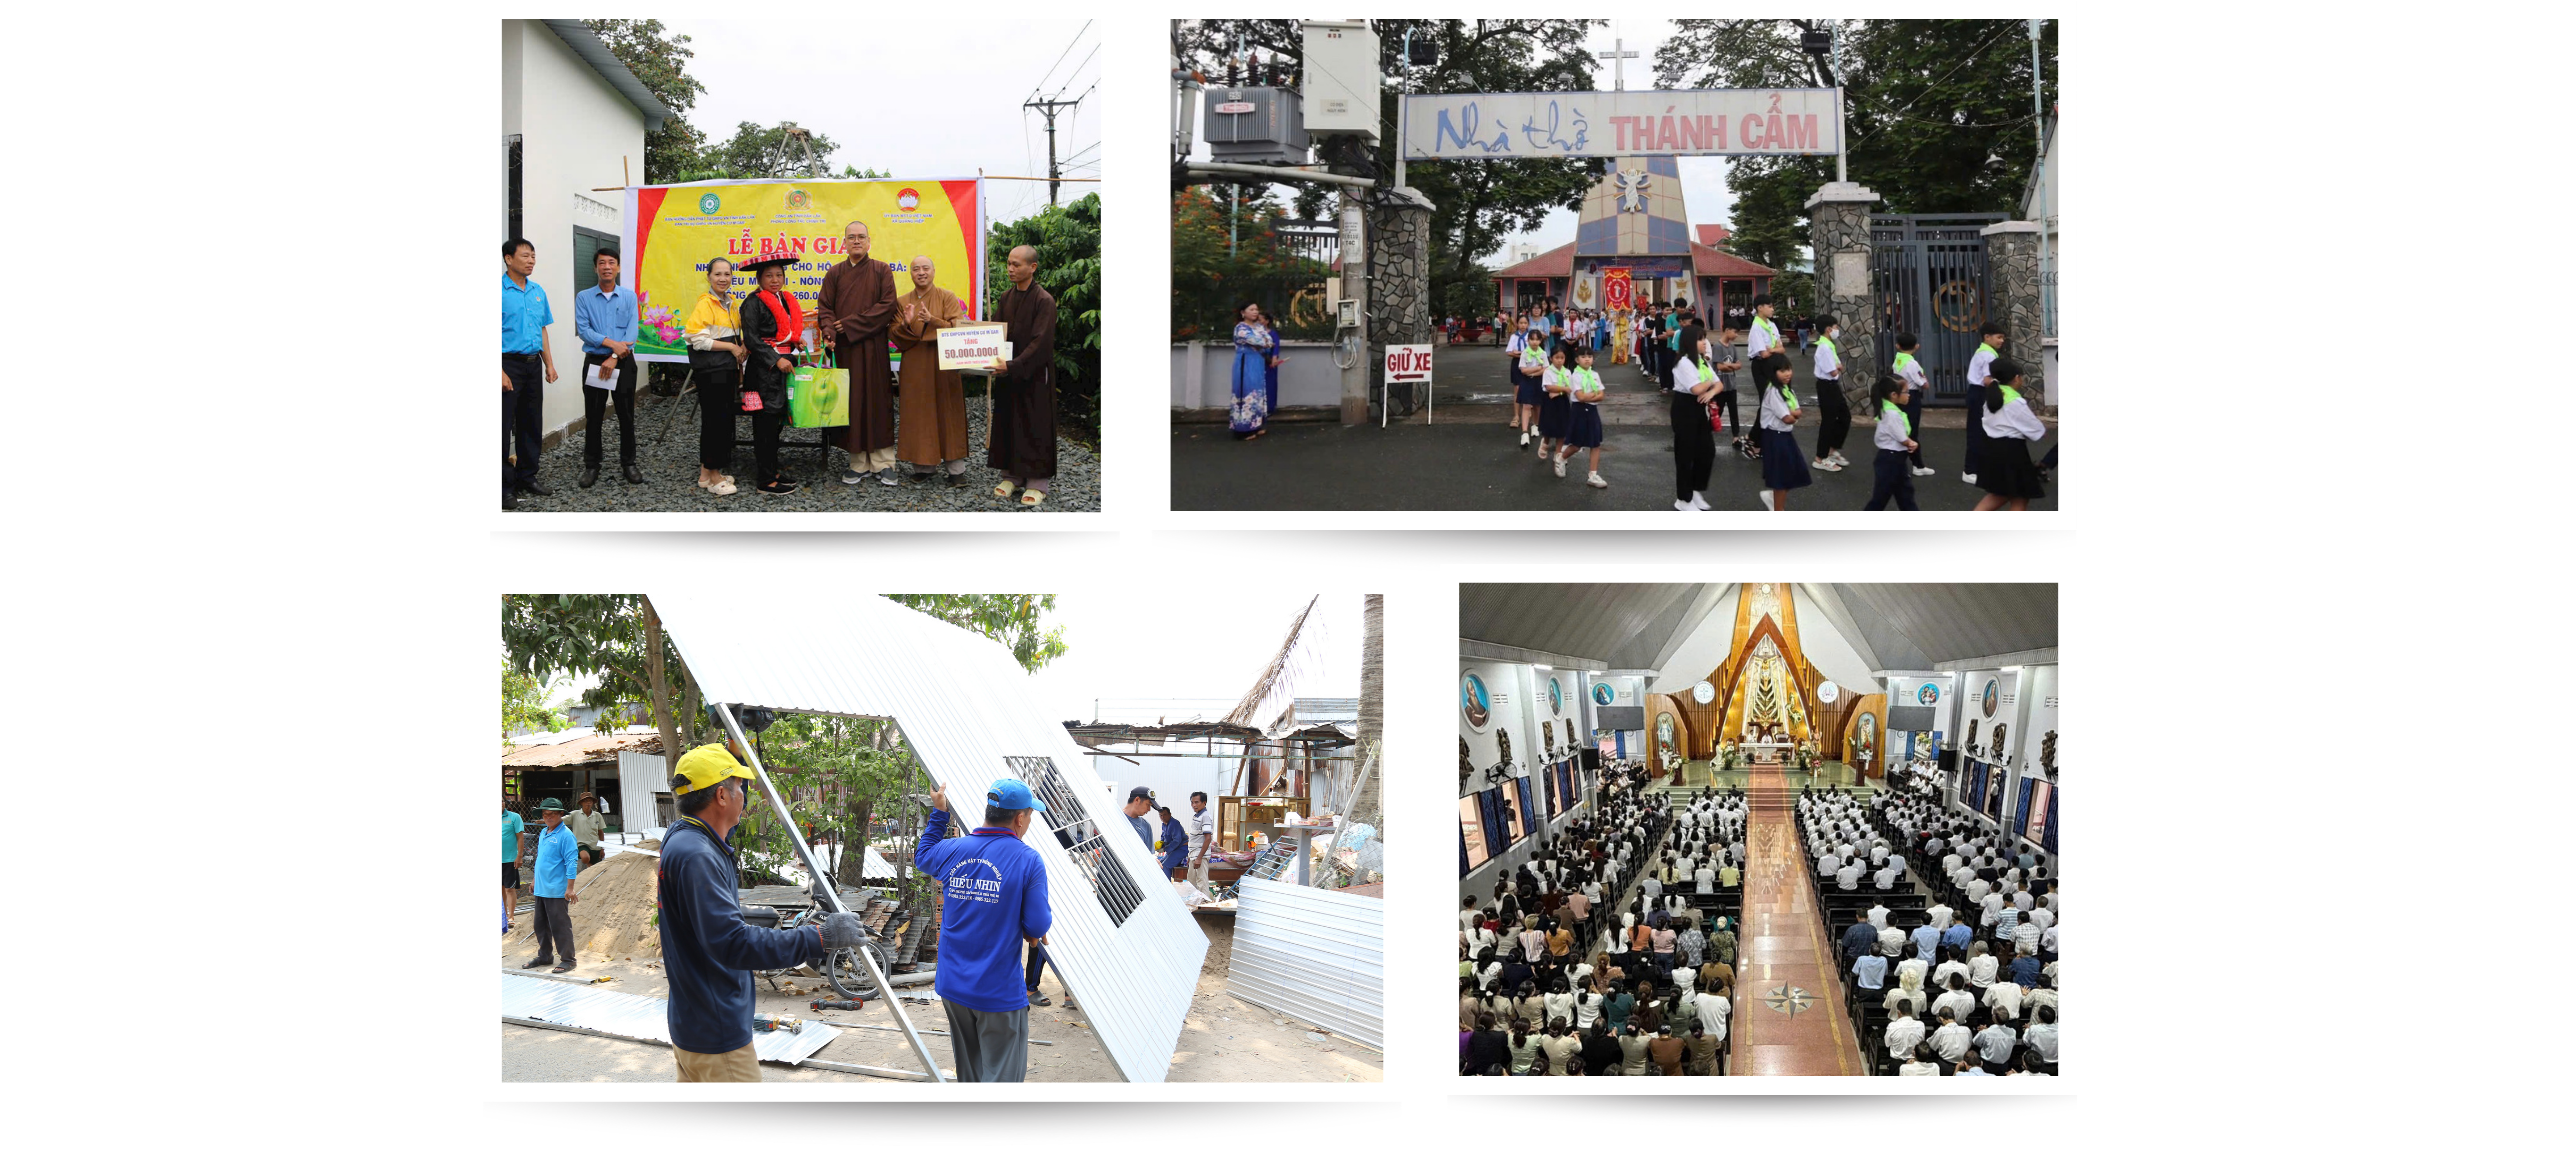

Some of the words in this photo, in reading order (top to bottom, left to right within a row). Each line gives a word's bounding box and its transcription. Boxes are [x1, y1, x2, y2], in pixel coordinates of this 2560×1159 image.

[1436, 101, 1511, 152] Nhà
[1609, 106, 1727, 150] THÁNH
[1740, 93, 1818, 150] CẨM
[728, 228, 753, 254] LỄ
[760, 232, 807, 254] BÀN
[792, 262, 812, 271] CHO
[945, 347, 998, 359] 50.000.000đ
[1388, 347, 1412, 372] GIỮ
[1414, 353, 1431, 371] XE
[950, 874, 973, 889] HIẾU
[974, 879, 1001, 892] NHIN
